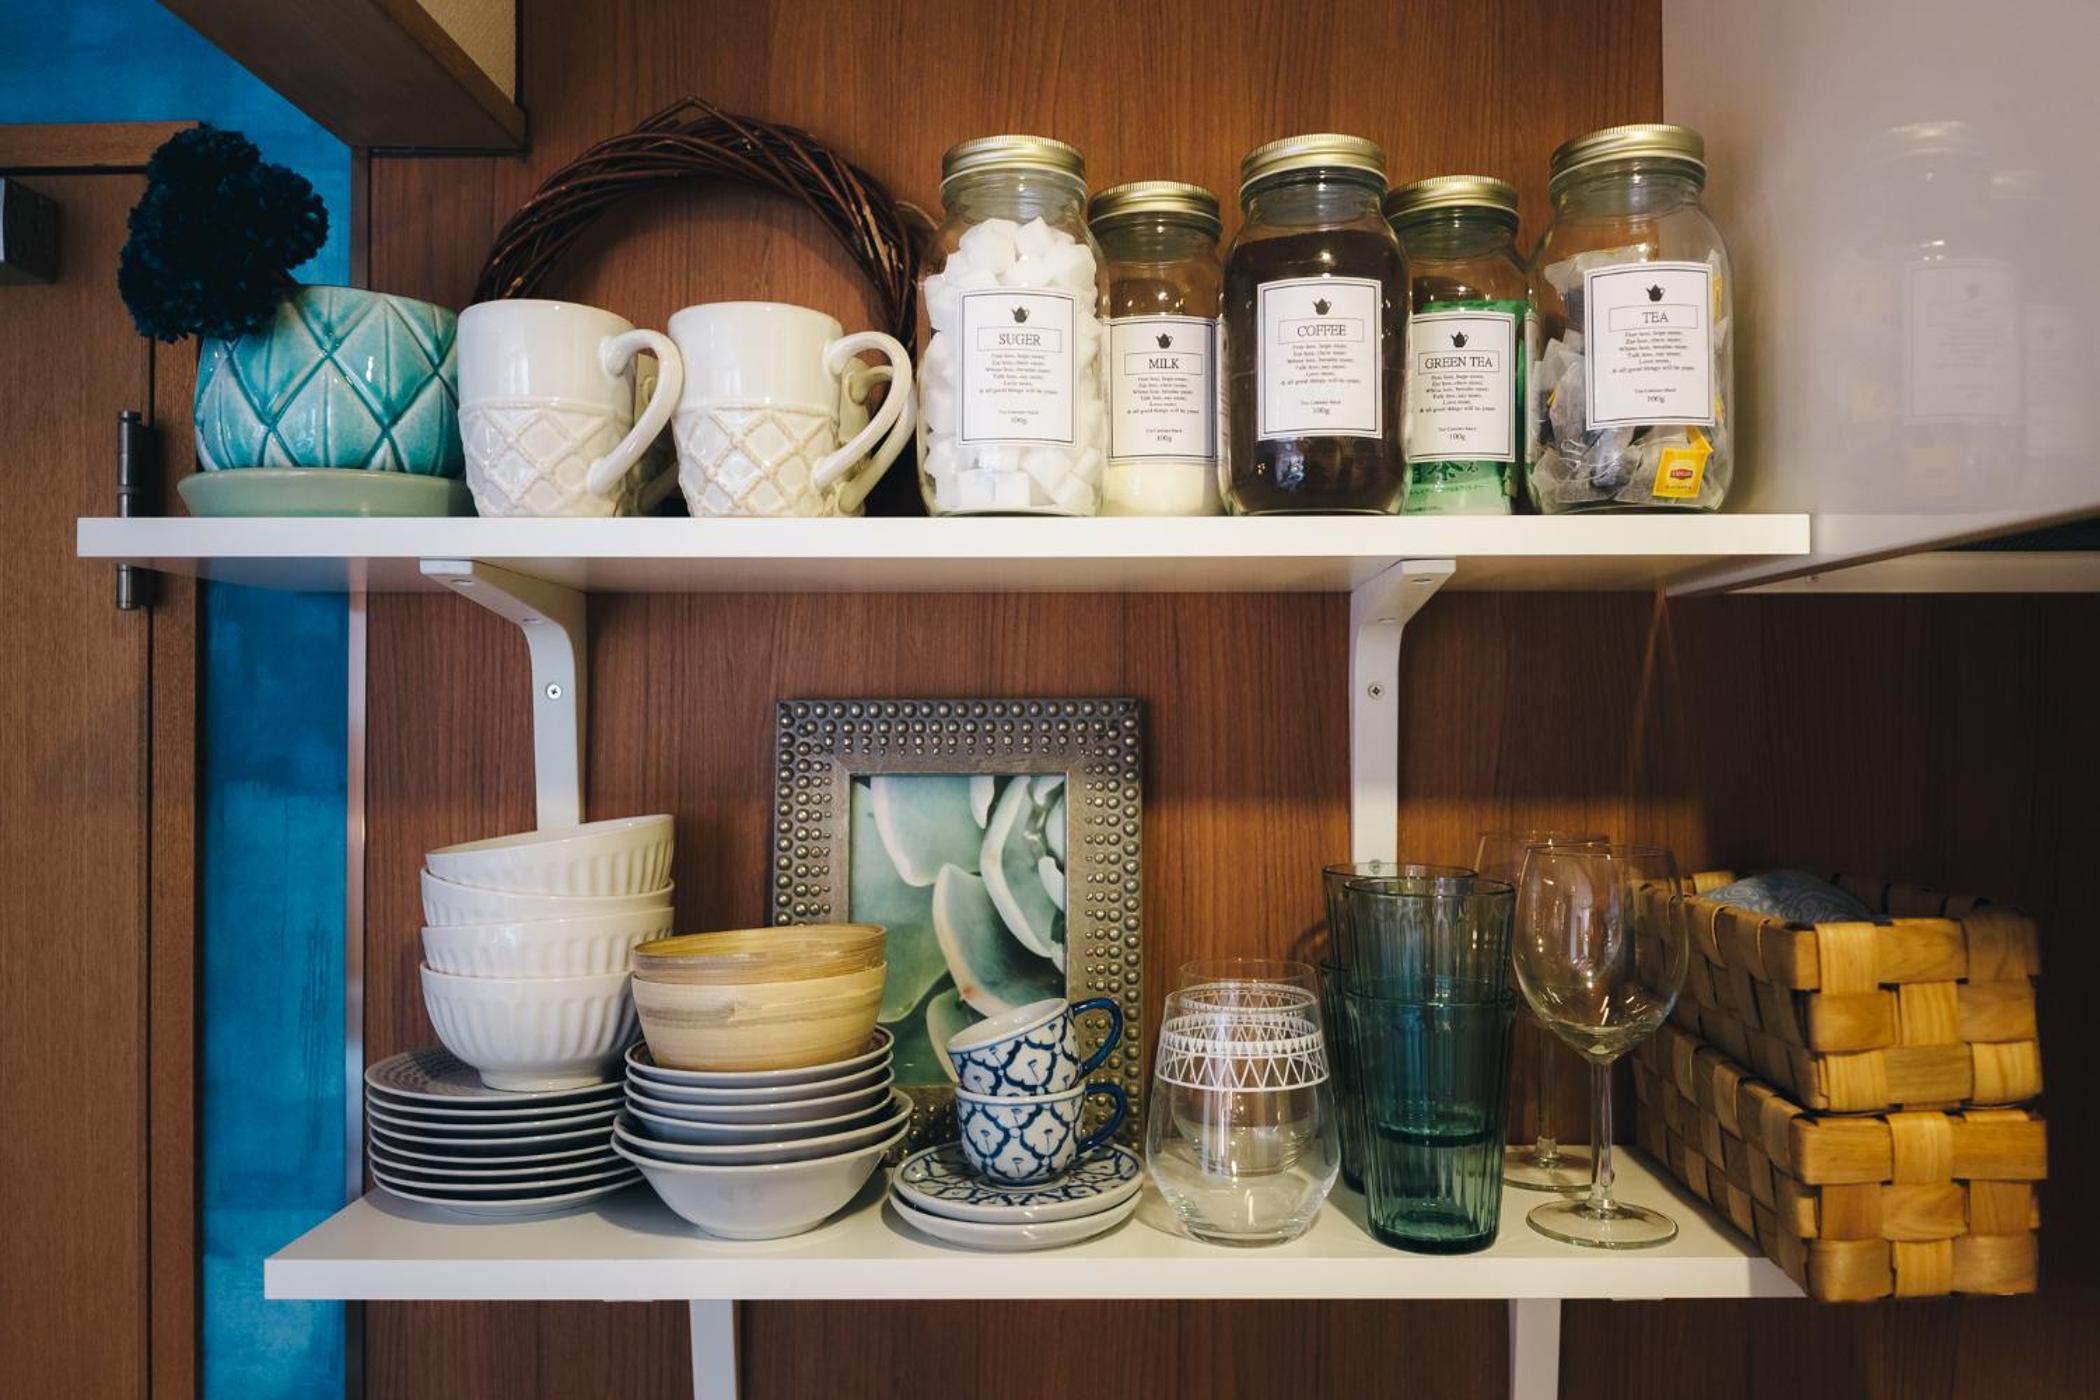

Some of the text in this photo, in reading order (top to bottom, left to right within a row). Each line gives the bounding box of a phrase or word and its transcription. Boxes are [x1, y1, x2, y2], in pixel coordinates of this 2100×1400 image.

[1641, 311, 1669, 324] TEA
[1297, 324, 1347, 337] COFFEE
[998, 333, 1041, 346] SUGER
[1148, 358, 1180, 369] MILK
[1424, 356, 1493, 369] GREEN TEA
